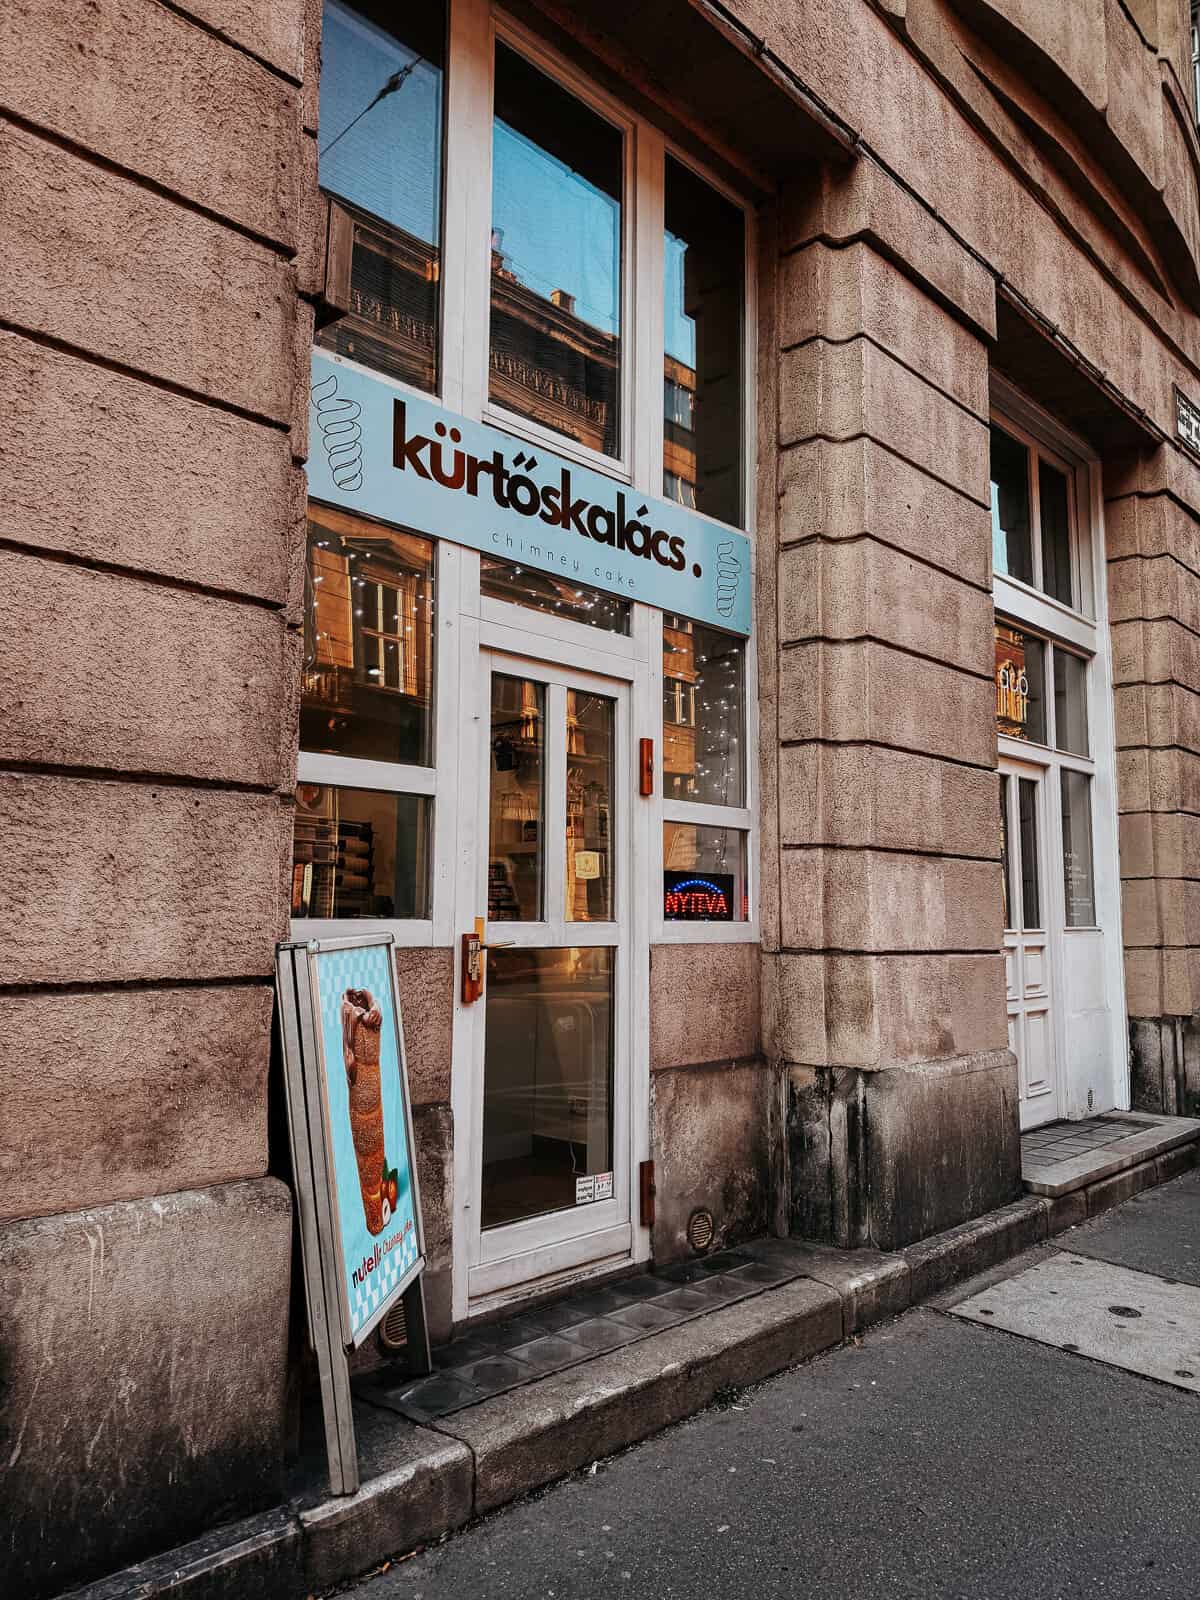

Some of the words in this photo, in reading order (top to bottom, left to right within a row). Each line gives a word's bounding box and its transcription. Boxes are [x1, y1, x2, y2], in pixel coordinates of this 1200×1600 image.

[491, 531, 580, 570] chimney
[593, 566, 636, 588] cake
[664, 892, 728, 913] NYITVA
